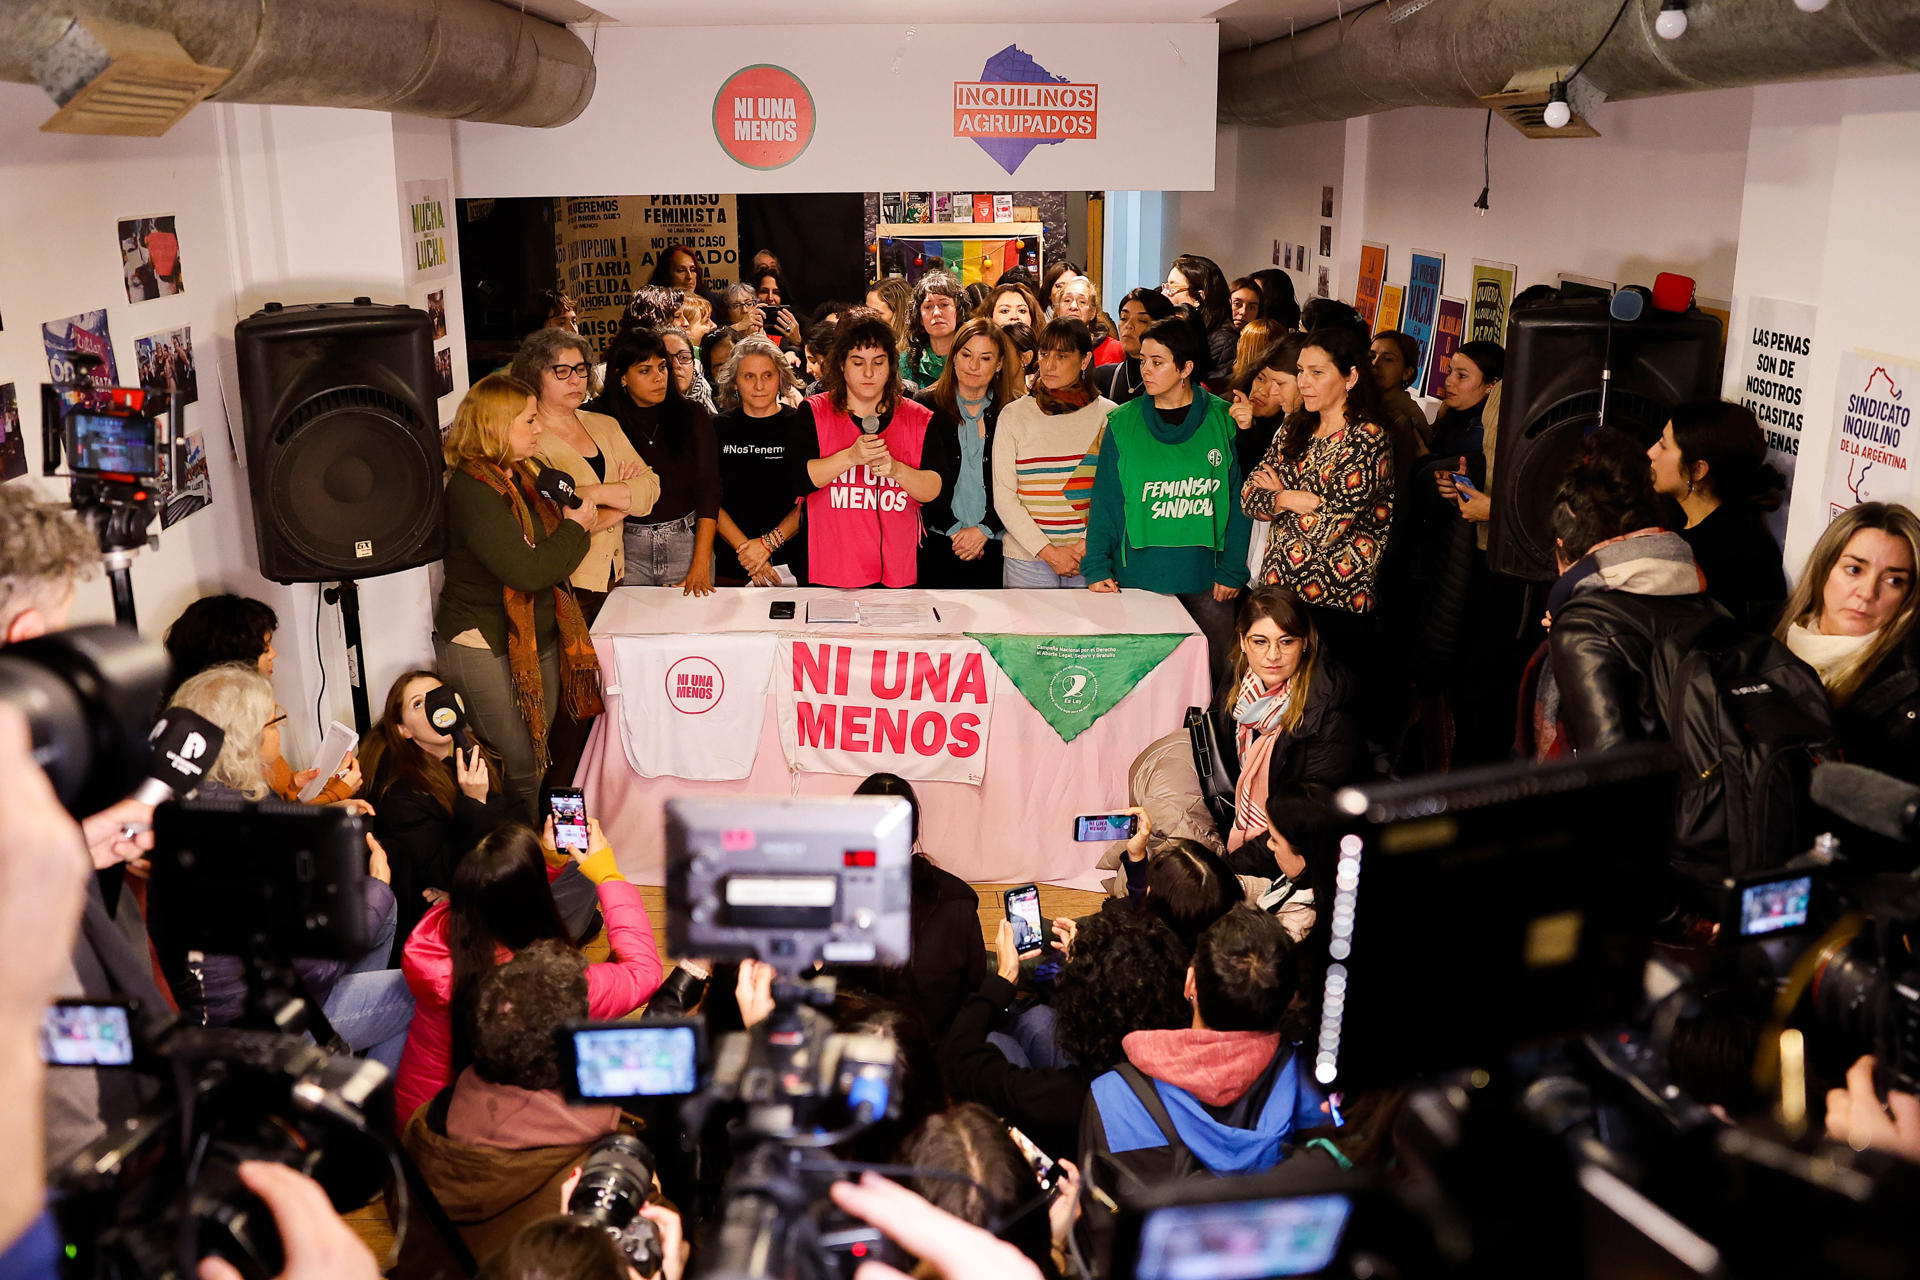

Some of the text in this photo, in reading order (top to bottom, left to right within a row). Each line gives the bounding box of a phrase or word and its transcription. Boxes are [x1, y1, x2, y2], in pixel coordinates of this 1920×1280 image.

[734, 97, 797, 119] NI UNA
[958, 87, 1093, 107] INQUILINOS
[734, 120, 797, 141] MENOS
[958, 113, 1092, 134] AGRUPADOS
[411, 201, 445, 233] MUCHA
[644, 208, 727, 223] FEMINISTA
[416, 237, 447, 270] LUCHA
[651, 235, 726, 249] NO ES UN CASO
[1476, 286, 1499, 302] QUIERO
[1474, 325, 1494, 342] PERO
[1753, 328, 1811, 356] LAS PENAS
[1757, 353, 1796, 379] SON DE
[1746, 375, 1802, 406] NOSOTROS
[1758, 403, 1803, 432] CASITAS
[1848, 394, 1911, 427] SINDICATO
[1843, 415, 1901, 448] INQUILINO
[1840, 438, 1850, 453] DE
[1851, 441, 1861, 456] LA
[830, 486, 908, 512] MENOS
[677, 673, 713, 687] NI UNA
[792, 641, 852, 696] NI
[870, 649, 988, 704] UNA
[676, 686, 713, 700] MENOS
[796, 701, 981, 758] MENOS
